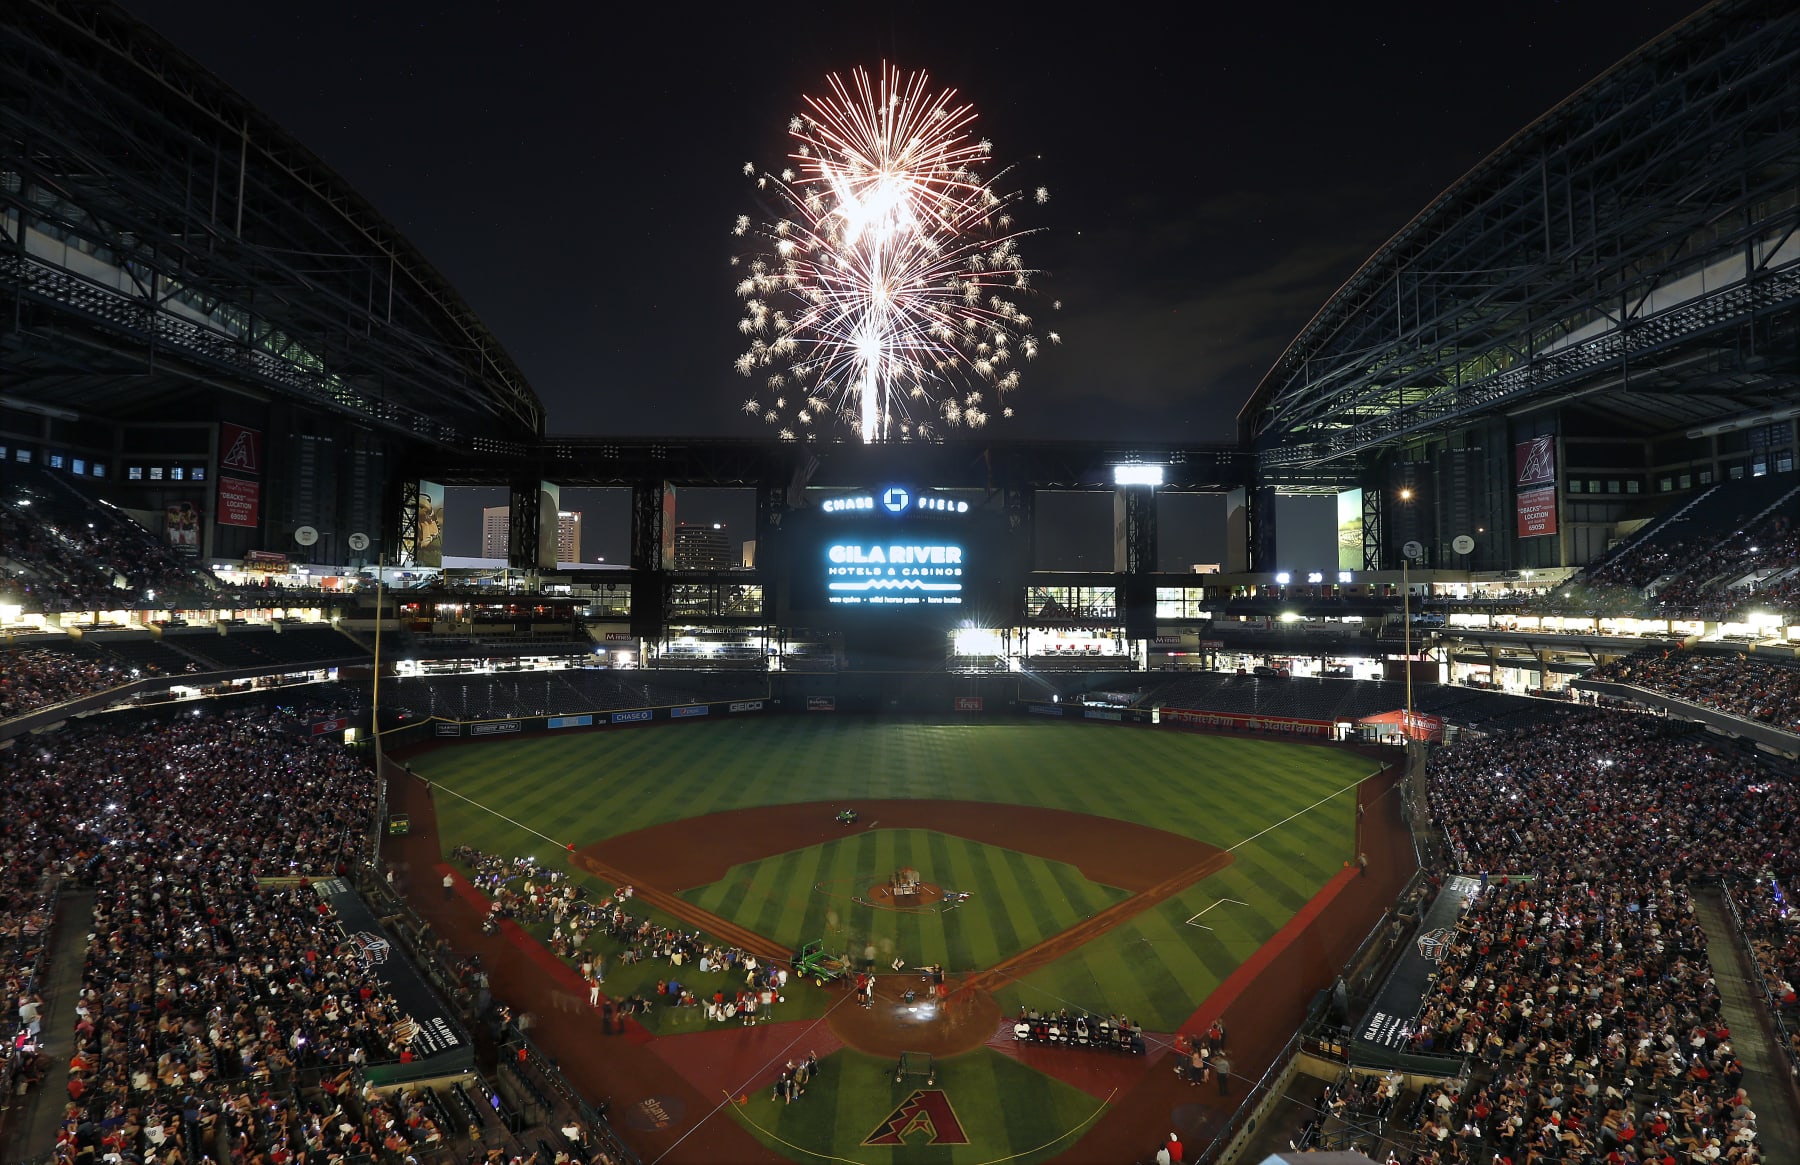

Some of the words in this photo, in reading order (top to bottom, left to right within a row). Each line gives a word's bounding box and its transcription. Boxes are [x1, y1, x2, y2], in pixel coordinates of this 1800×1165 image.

[226, 500, 252, 510] LOCATION
[823, 497, 873, 512] CHASE
[918, 498, 968, 512] FIELD
[1524, 512, 1548, 520] LOCATION
[829, 545, 885, 563] GILA
[889, 546, 962, 563] RIVER
[248, 561, 288, 571] SANDLOT
[829, 567, 882, 576] HOTELS
[888, 568, 896, 576] &
[902, 568, 962, 576] CASINOS
[1308, 572, 1322, 582] 20
[1272, 622, 1306, 630] ULTRA
[730, 702, 762, 711] GEICO
[616, 712, 640, 721] CHASE
[1370, 1012, 1386, 1028] RIVER
[432, 1018, 447, 1030] GILA
[440, 1028, 460, 1046] RIVER
[1364, 1027, 1378, 1040] GILA
[644, 1098, 670, 1121] shaw
